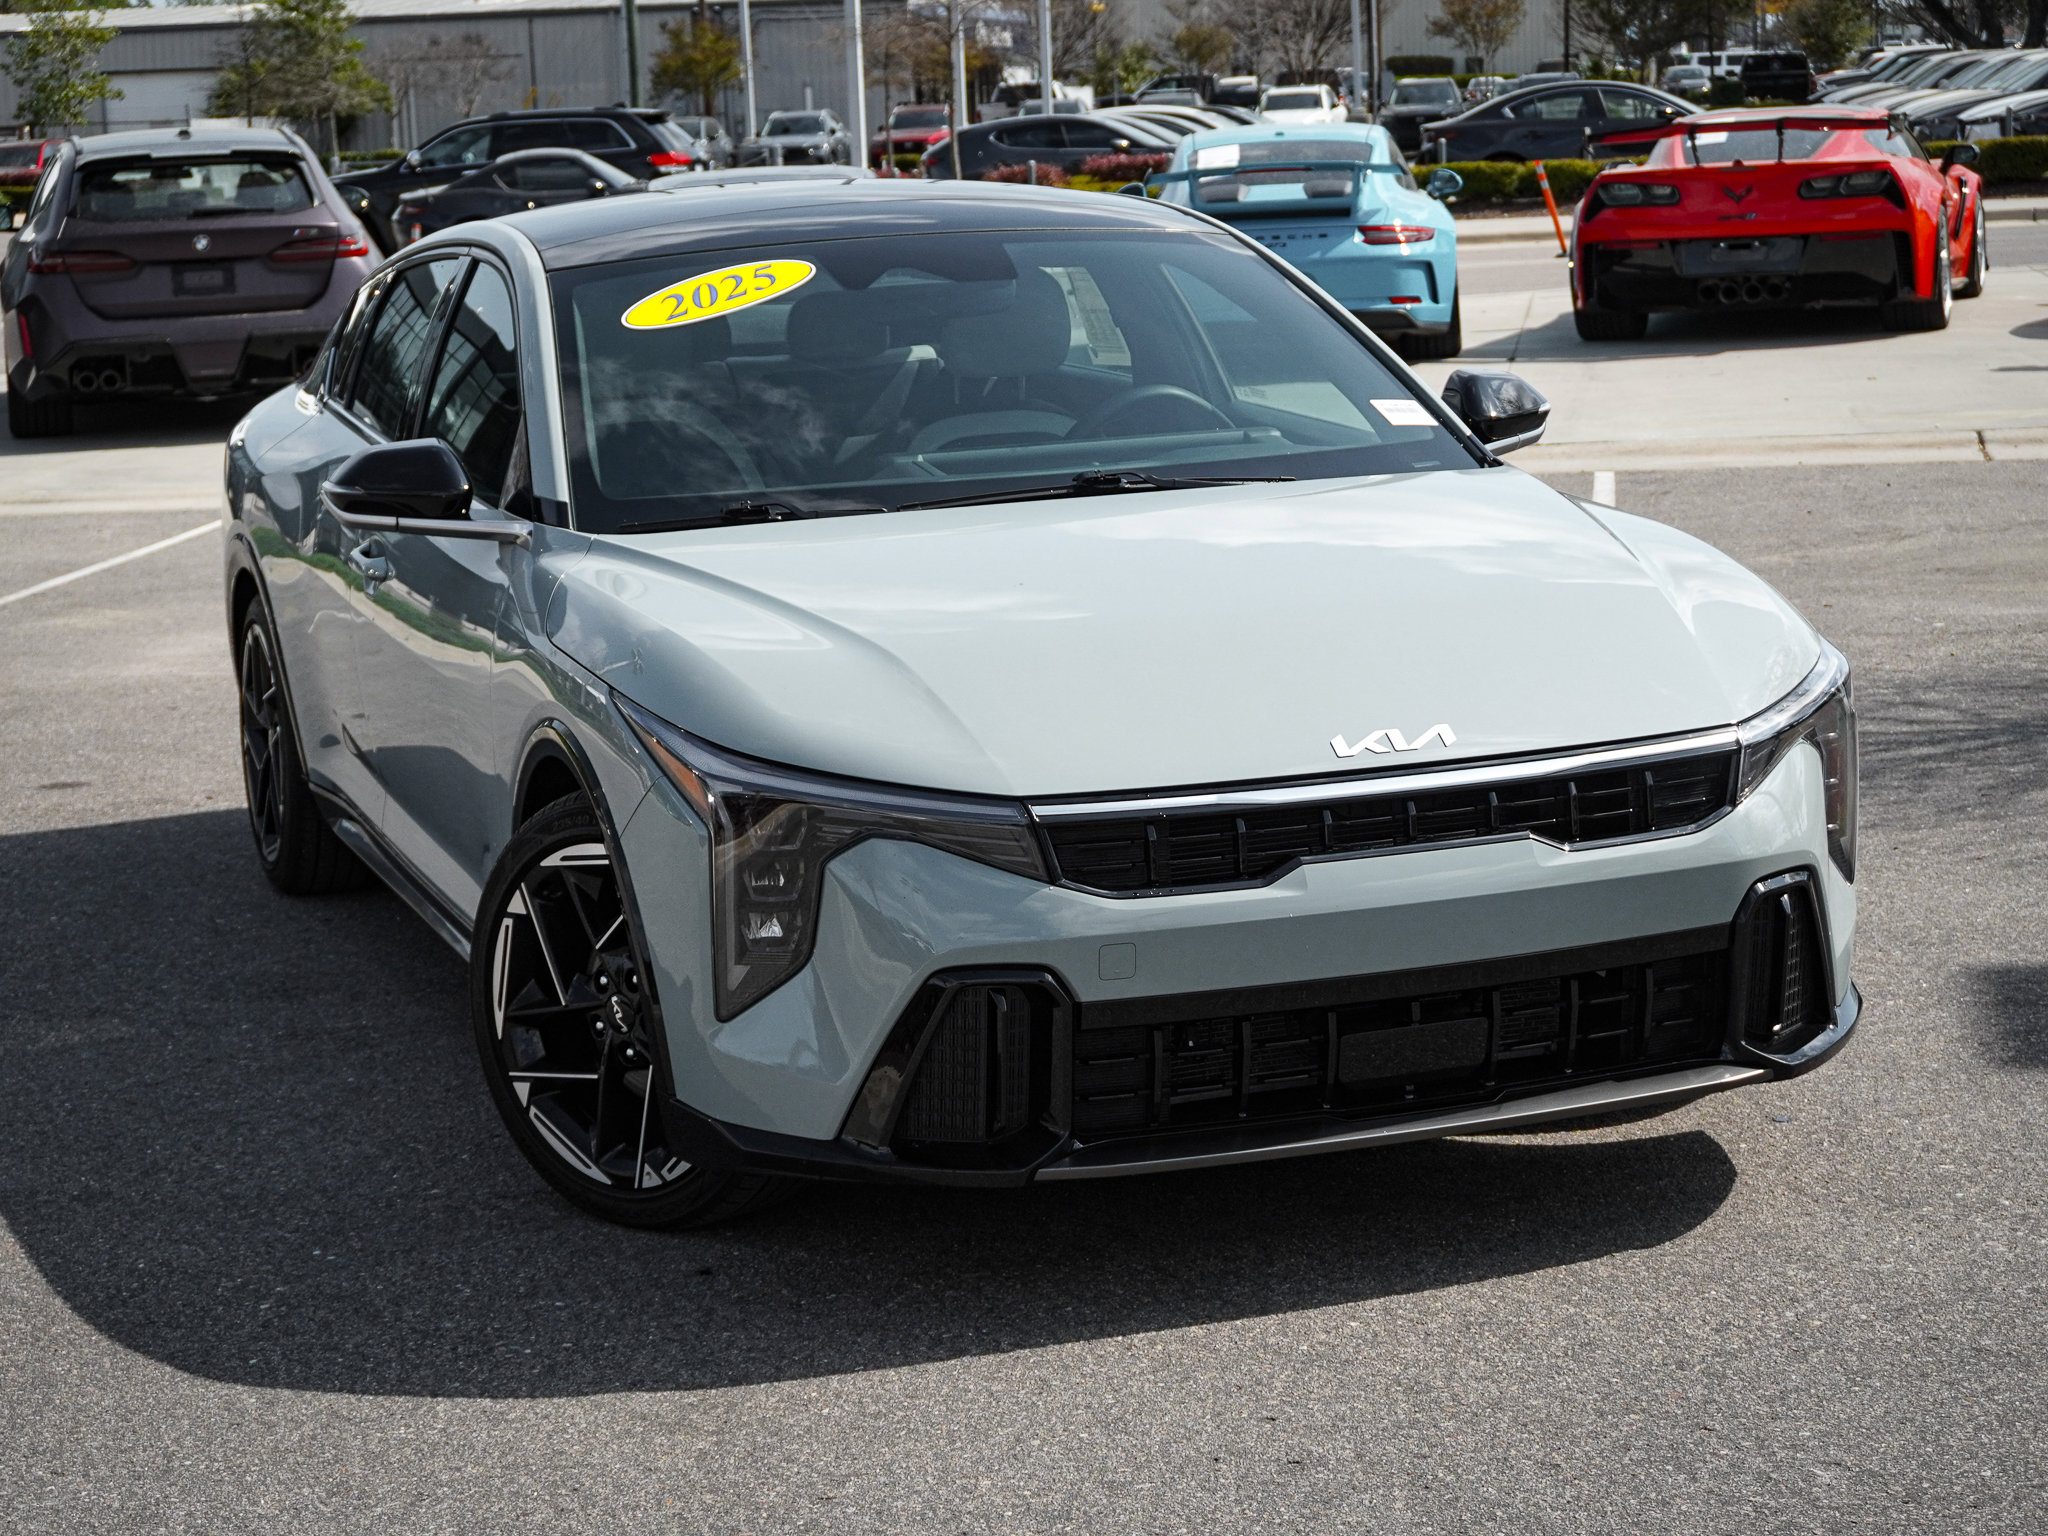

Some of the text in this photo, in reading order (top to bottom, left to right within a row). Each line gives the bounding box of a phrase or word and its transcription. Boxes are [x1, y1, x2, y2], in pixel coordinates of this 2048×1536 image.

[661, 264, 776, 321] 2025
[1330, 723, 1457, 758] KIA
[611, 995, 628, 1032] KIA
